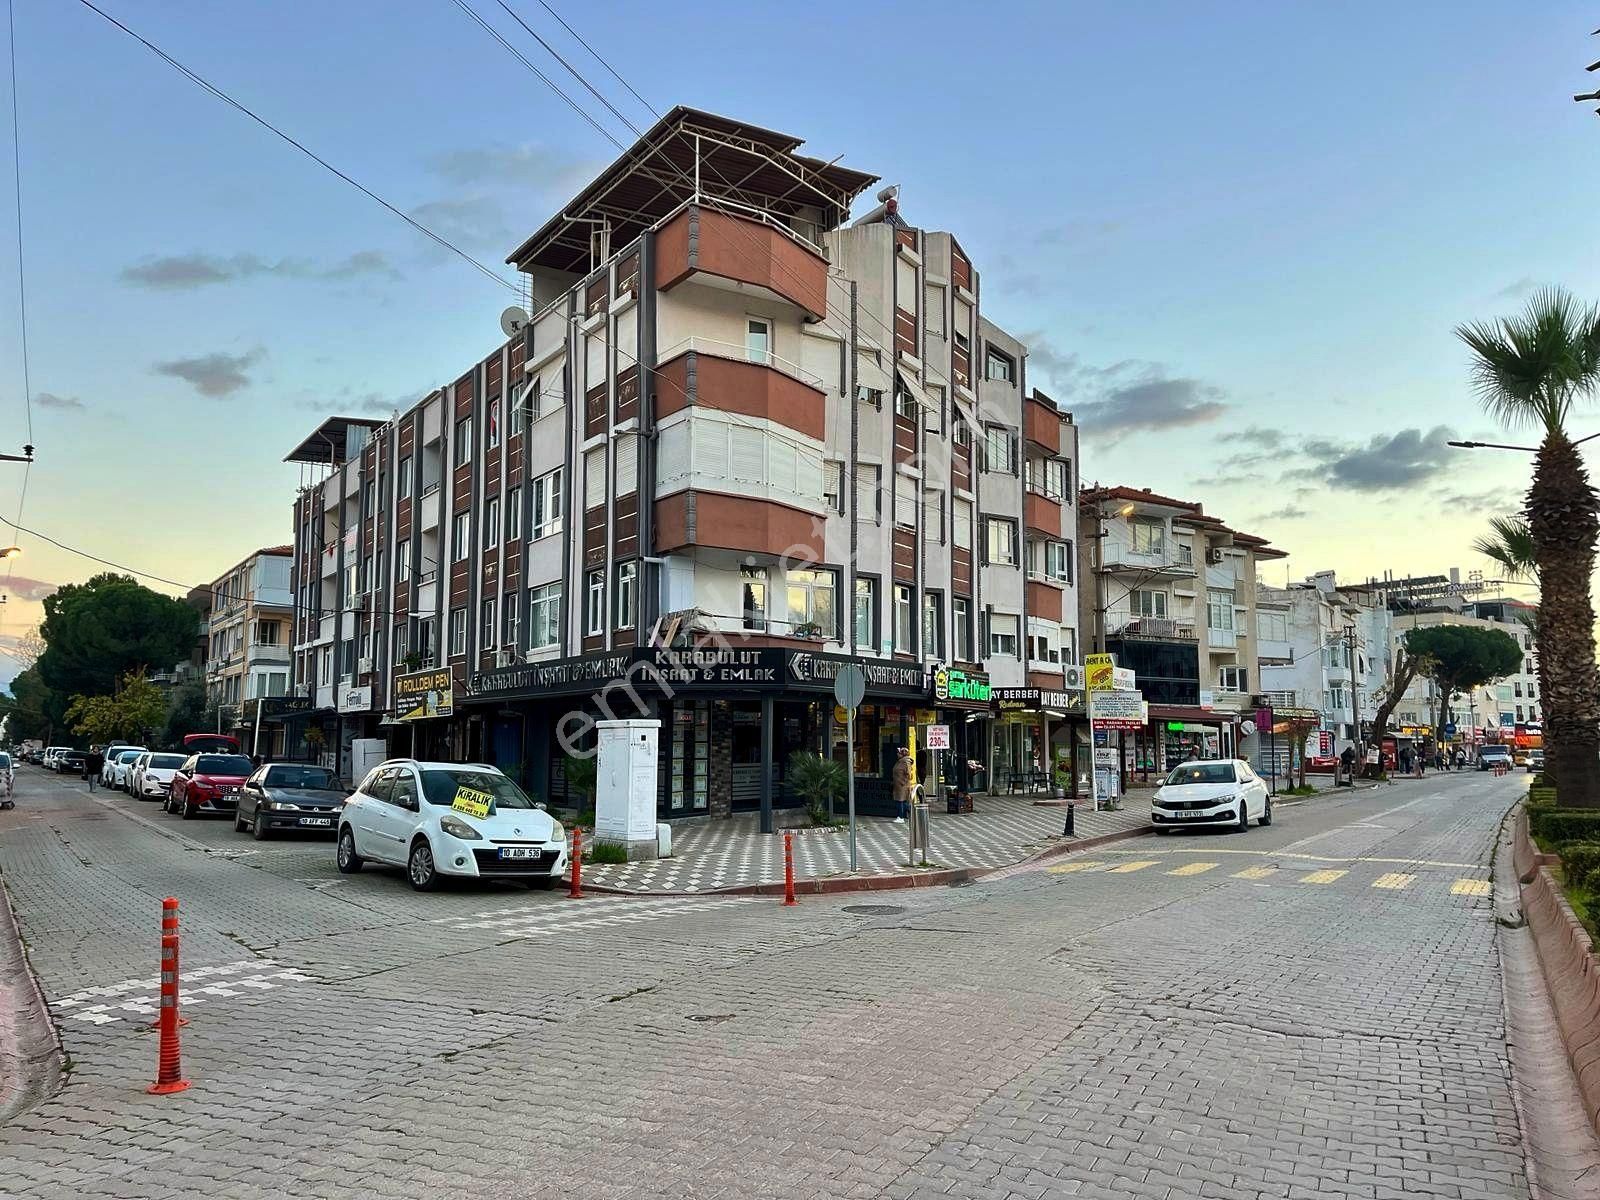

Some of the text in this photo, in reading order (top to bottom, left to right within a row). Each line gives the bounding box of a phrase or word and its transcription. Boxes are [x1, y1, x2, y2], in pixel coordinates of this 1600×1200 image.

[655, 651, 762, 665] KARABULUT
[435, 672, 449, 689] PEN
[703, 668, 715, 681] &
[720, 668, 775, 681] EMLAK
[1003, 689, 1039, 699] BERBER
[503, 849, 510, 857] 10
